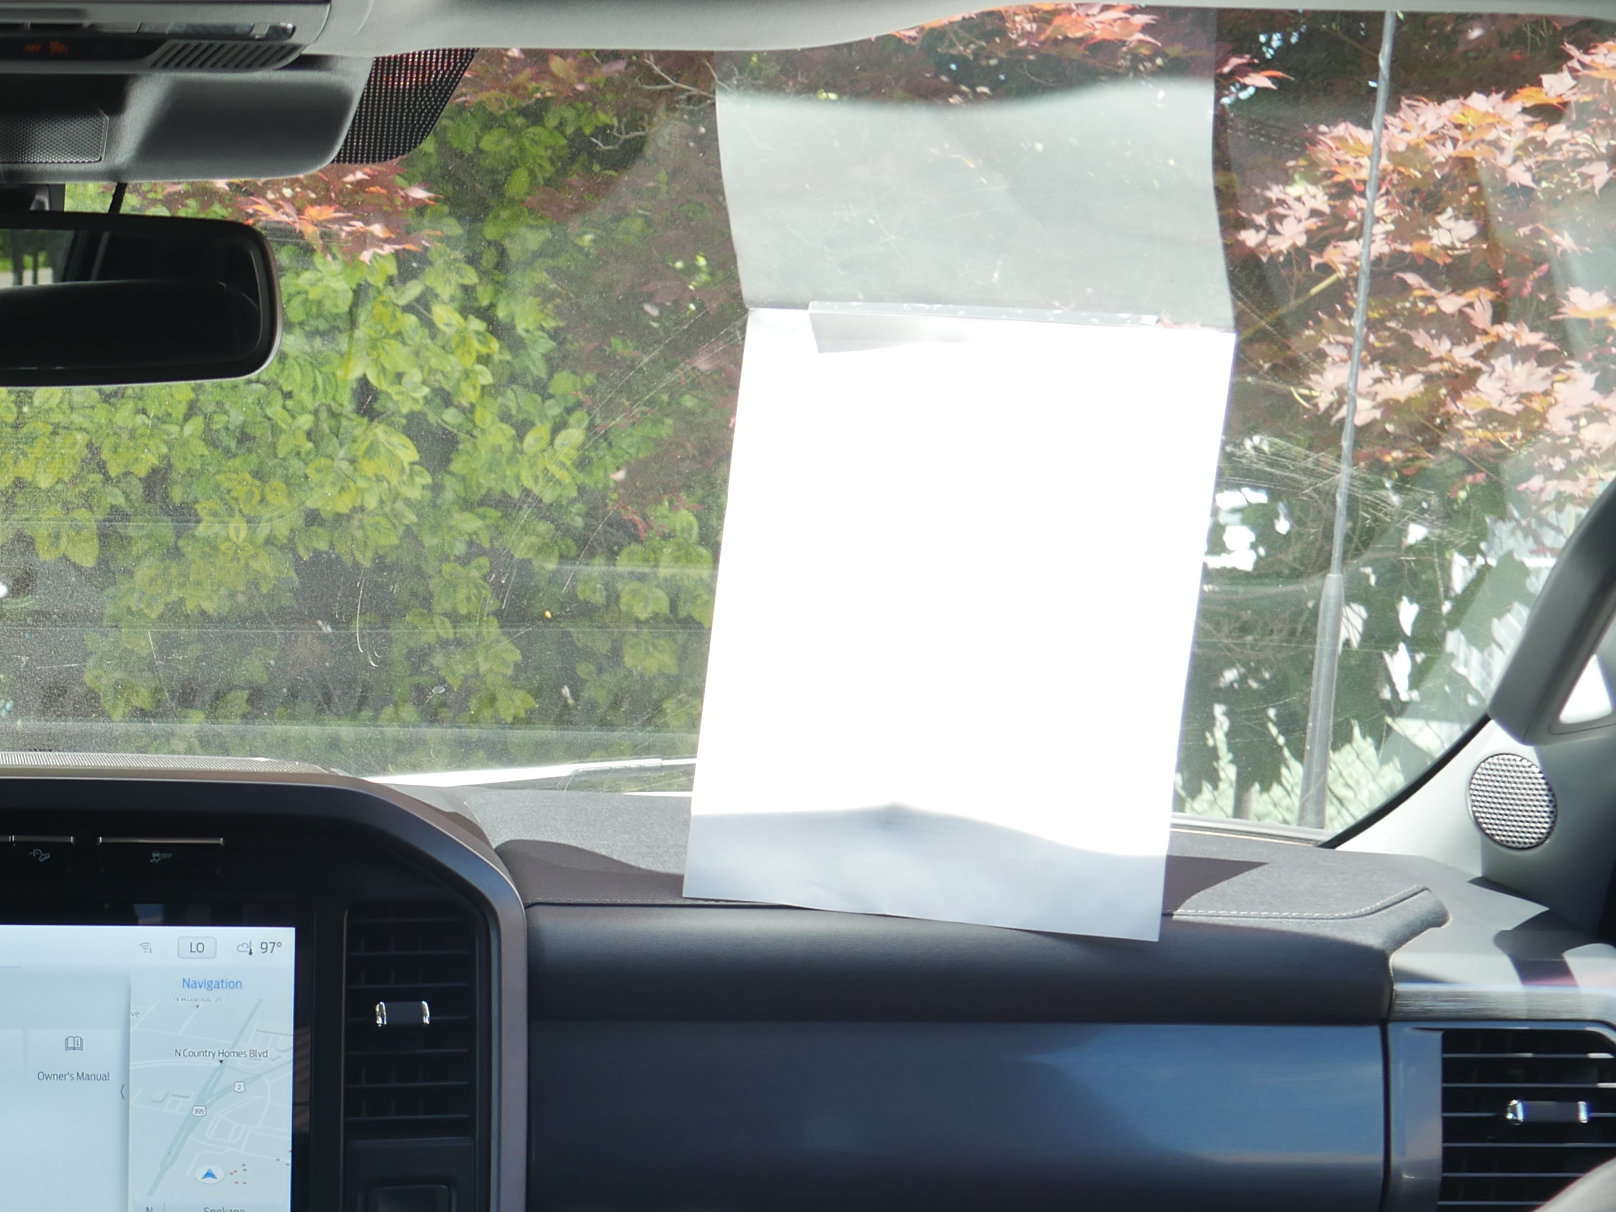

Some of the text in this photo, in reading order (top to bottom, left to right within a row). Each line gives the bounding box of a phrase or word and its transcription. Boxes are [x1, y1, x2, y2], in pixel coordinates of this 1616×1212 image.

[189, 942, 205, 954] LO
[182, 978, 243, 992] Navigation
[175, 1049, 268, 1060] N Country Homes Blvd
[37, 1071, 110, 1082] Owner's Manual
